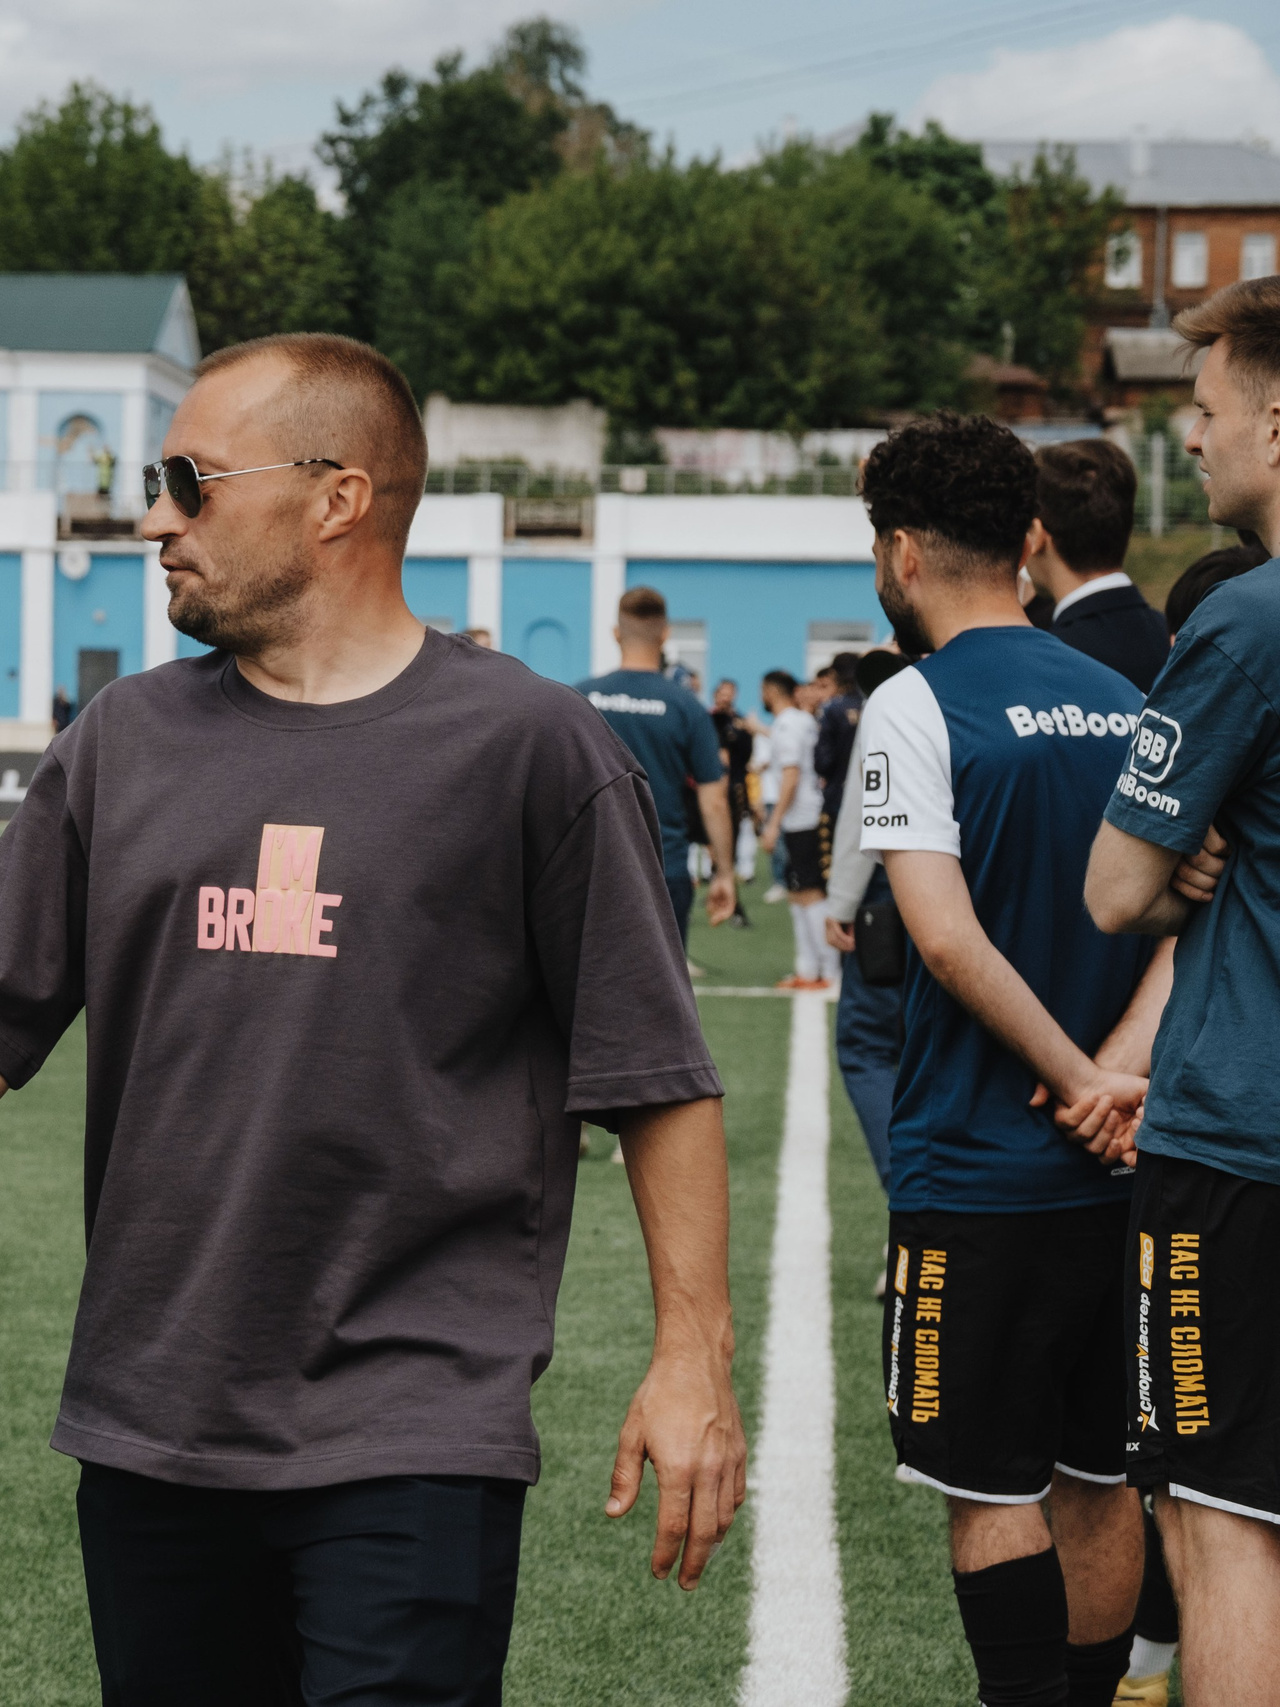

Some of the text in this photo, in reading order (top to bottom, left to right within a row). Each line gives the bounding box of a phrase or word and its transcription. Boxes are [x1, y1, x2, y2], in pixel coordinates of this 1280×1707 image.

[1137, 726, 1168, 763] BB
[259, 827, 321, 891] I'M
[197, 886, 343, 958] BROKE
[896, 1249, 909, 1291] PRO
[1142, 1237, 1154, 1285] PRO
[911, 1249, 947, 1423] НАС НЕ СЛОМАТЬ
[1170, 1232, 1210, 1435] НАС НЕ СЛОМАТЬ
